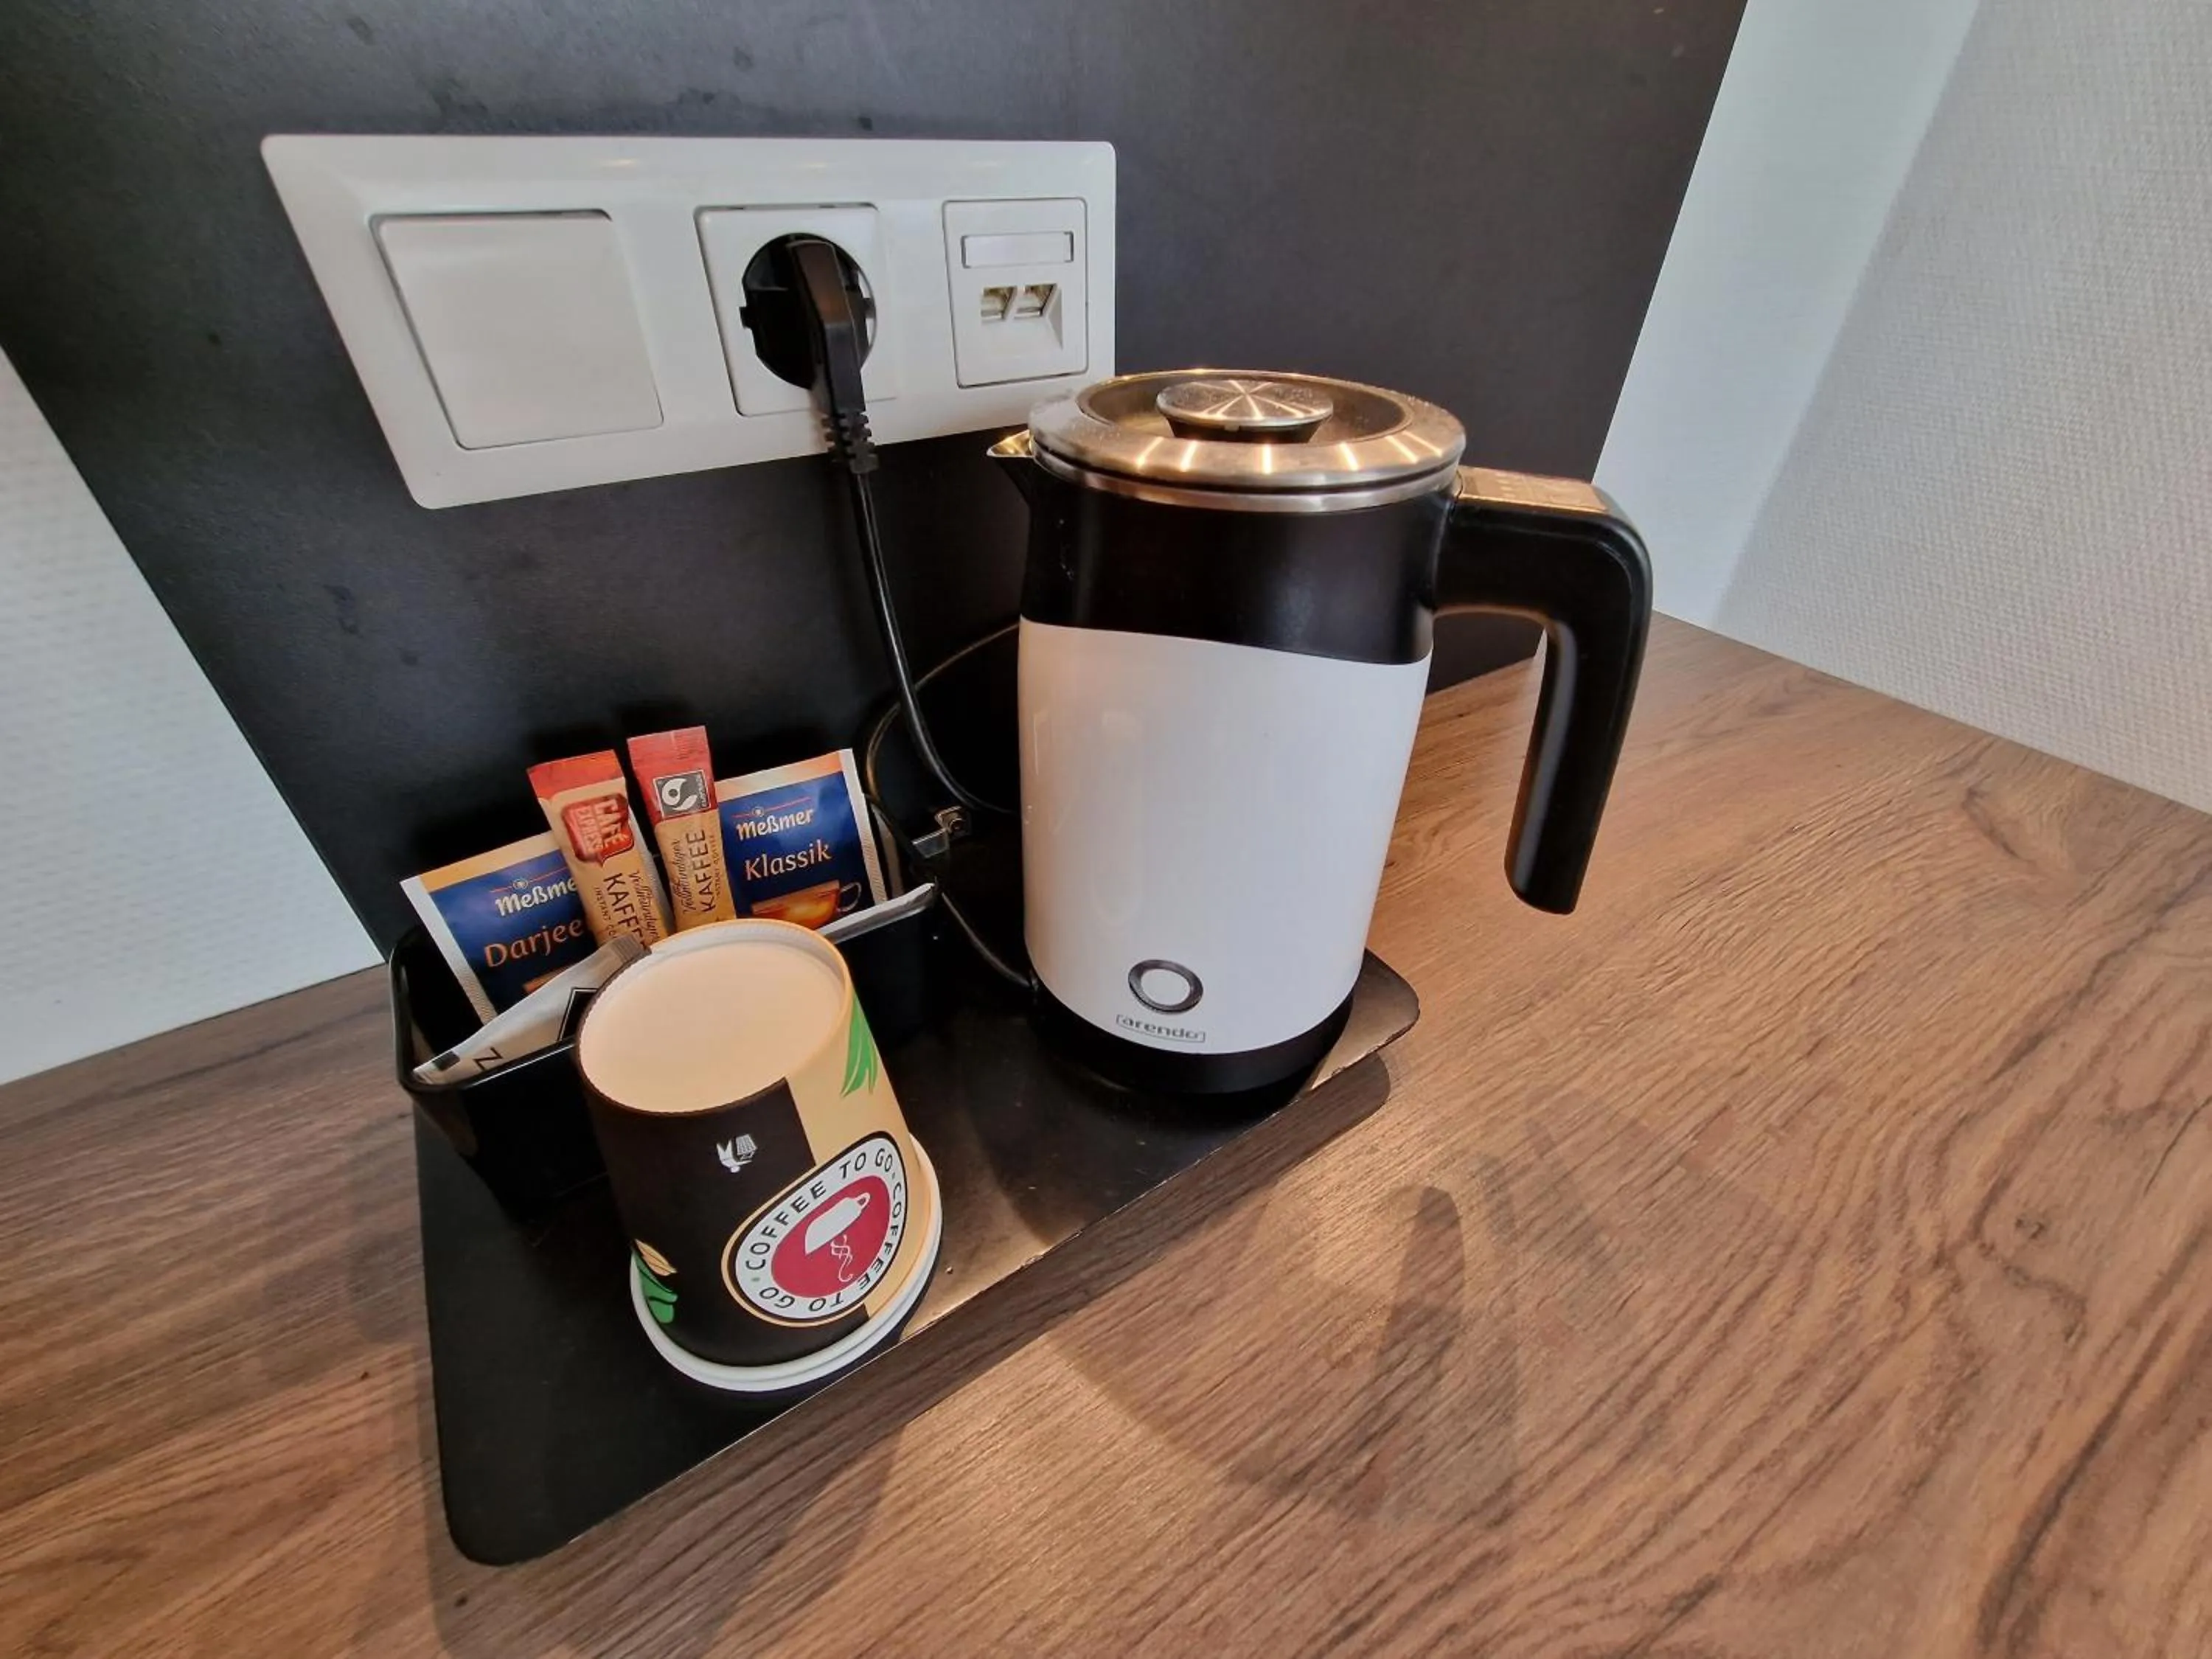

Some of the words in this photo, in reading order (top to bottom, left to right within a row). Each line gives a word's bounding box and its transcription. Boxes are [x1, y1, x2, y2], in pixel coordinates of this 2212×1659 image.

[736, 809, 814, 841] Meßmer
[686, 830, 716, 912] KAFFEE
[745, 839, 832, 880] Klassik
[495, 877, 577, 917] Meßme
[484, 919, 583, 967] Darjee
[1120, 1016, 1200, 1039] arendo
[745, 1180, 826, 1270] COFFEE
[840, 1152, 866, 1179] TO
[874, 1147, 893, 1172] GO
[858, 1182, 902, 1290] COFFEE
[759, 1287, 795, 1309] GO
[808, 1293, 844, 1312] TO
